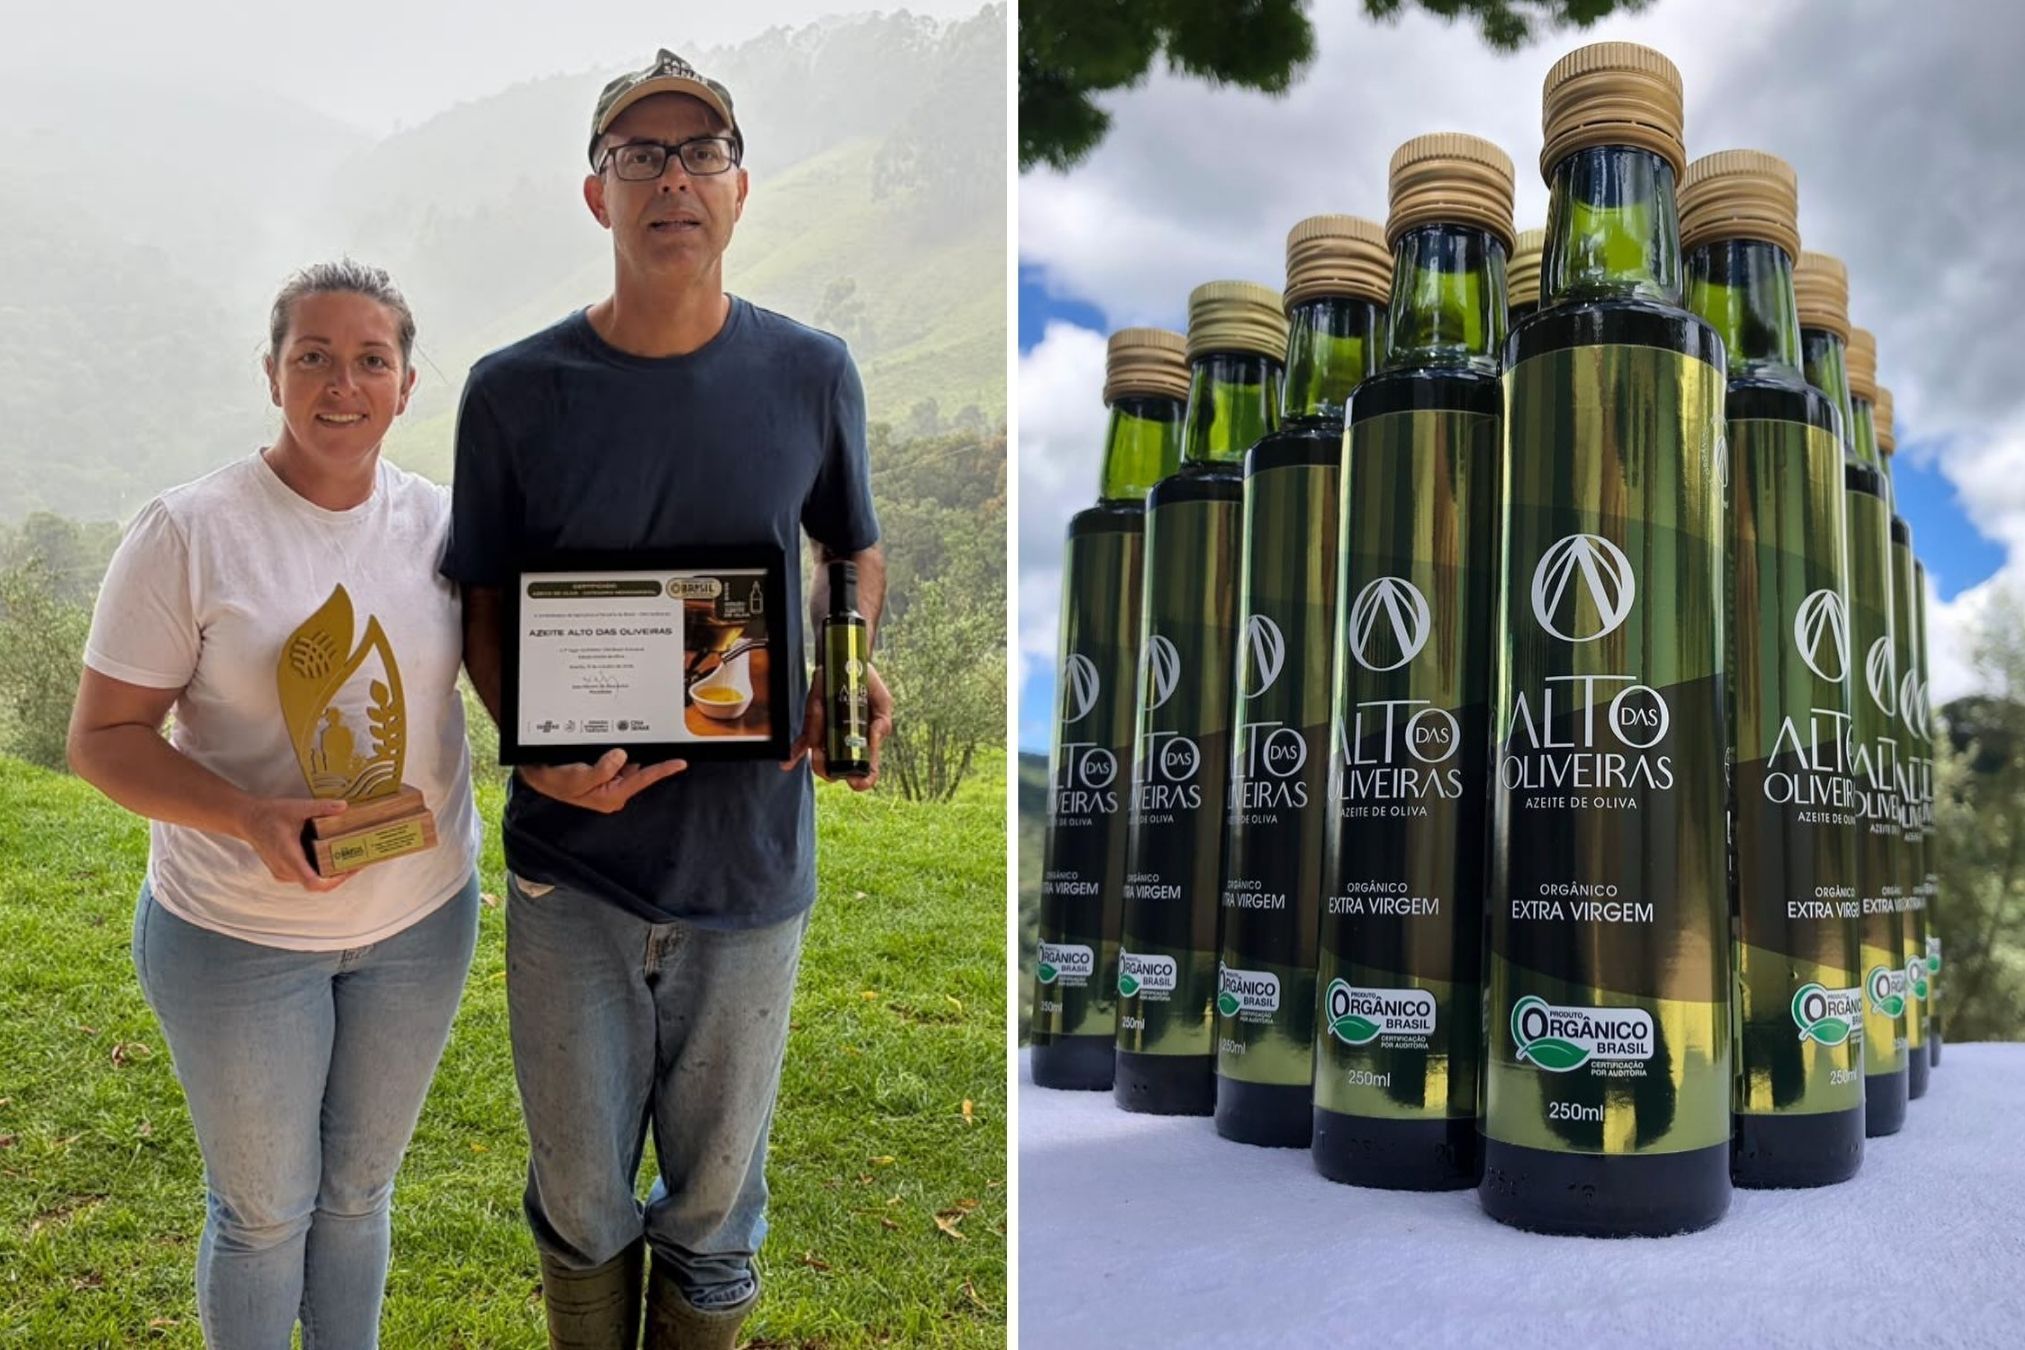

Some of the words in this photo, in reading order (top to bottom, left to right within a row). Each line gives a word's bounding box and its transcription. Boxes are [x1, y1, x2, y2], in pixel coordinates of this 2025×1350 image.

[529, 629, 564, 637] AZEITE
[596, 628, 617, 636] DAS
[620, 627, 673, 636] OLIVEIRAS
[1505, 675, 1670, 752] ALTO
[1621, 707, 1658, 727] DAS
[1416, 727, 1449, 744] DAS
[1167, 752, 1192, 766] DAS
[1270, 745, 1298, 760] DAS
[1086, 762, 1110, 775] DAS
[1502, 753, 1674, 790] OLIVEIRAS
[1328, 768, 1463, 802] OLIVEIRAS
[1764, 772, 1855, 808] OLIVEIR
[1525, 797, 1565, 809] AZEITE
[1570, 797, 1588, 809] DE
[1593, 797, 1638, 809] OLIVA
[1149, 814, 1175, 823] OLIVA
[1251, 814, 1278, 824] OLIVA
[1340, 807, 1369, 818] AZEITE
[1372, 807, 1387, 817] DE
[1390, 806, 1428, 817] OLIVA
[1798, 812, 1830, 824] AZEITE
[1056, 882, 1099, 895] VIRGEM
[1136, 885, 1181, 899] VIRGEM
[1347, 880, 1408, 893] ORGÂNICO
[1540, 881, 1618, 897] ORGÂNICO
[1237, 893, 1285, 909] VIRGEM
[1328, 896, 1364, 915] EXTRA
[1368, 897, 1439, 915] VIRGEM
[1863, 898, 1893, 914] EXTRA
[1512, 900, 1564, 920] EXTRA
[1569, 902, 1654, 923] VIRGEM
[1788, 901, 1834, 918] EXTRA
[1143, 977, 1173, 987] BRASIL
[1243, 996, 1276, 1007] BRASIL
[1549, 1010, 1583, 1019] PRODUTO
[1386, 1018, 1430, 1029] BRASIL
[1597, 1042, 1648, 1054] BRASIL
[1348, 1069, 1391, 1087] 250ml
[1591, 1069, 1606, 1077] POR
[1549, 1101, 1604, 1122] 250ml
